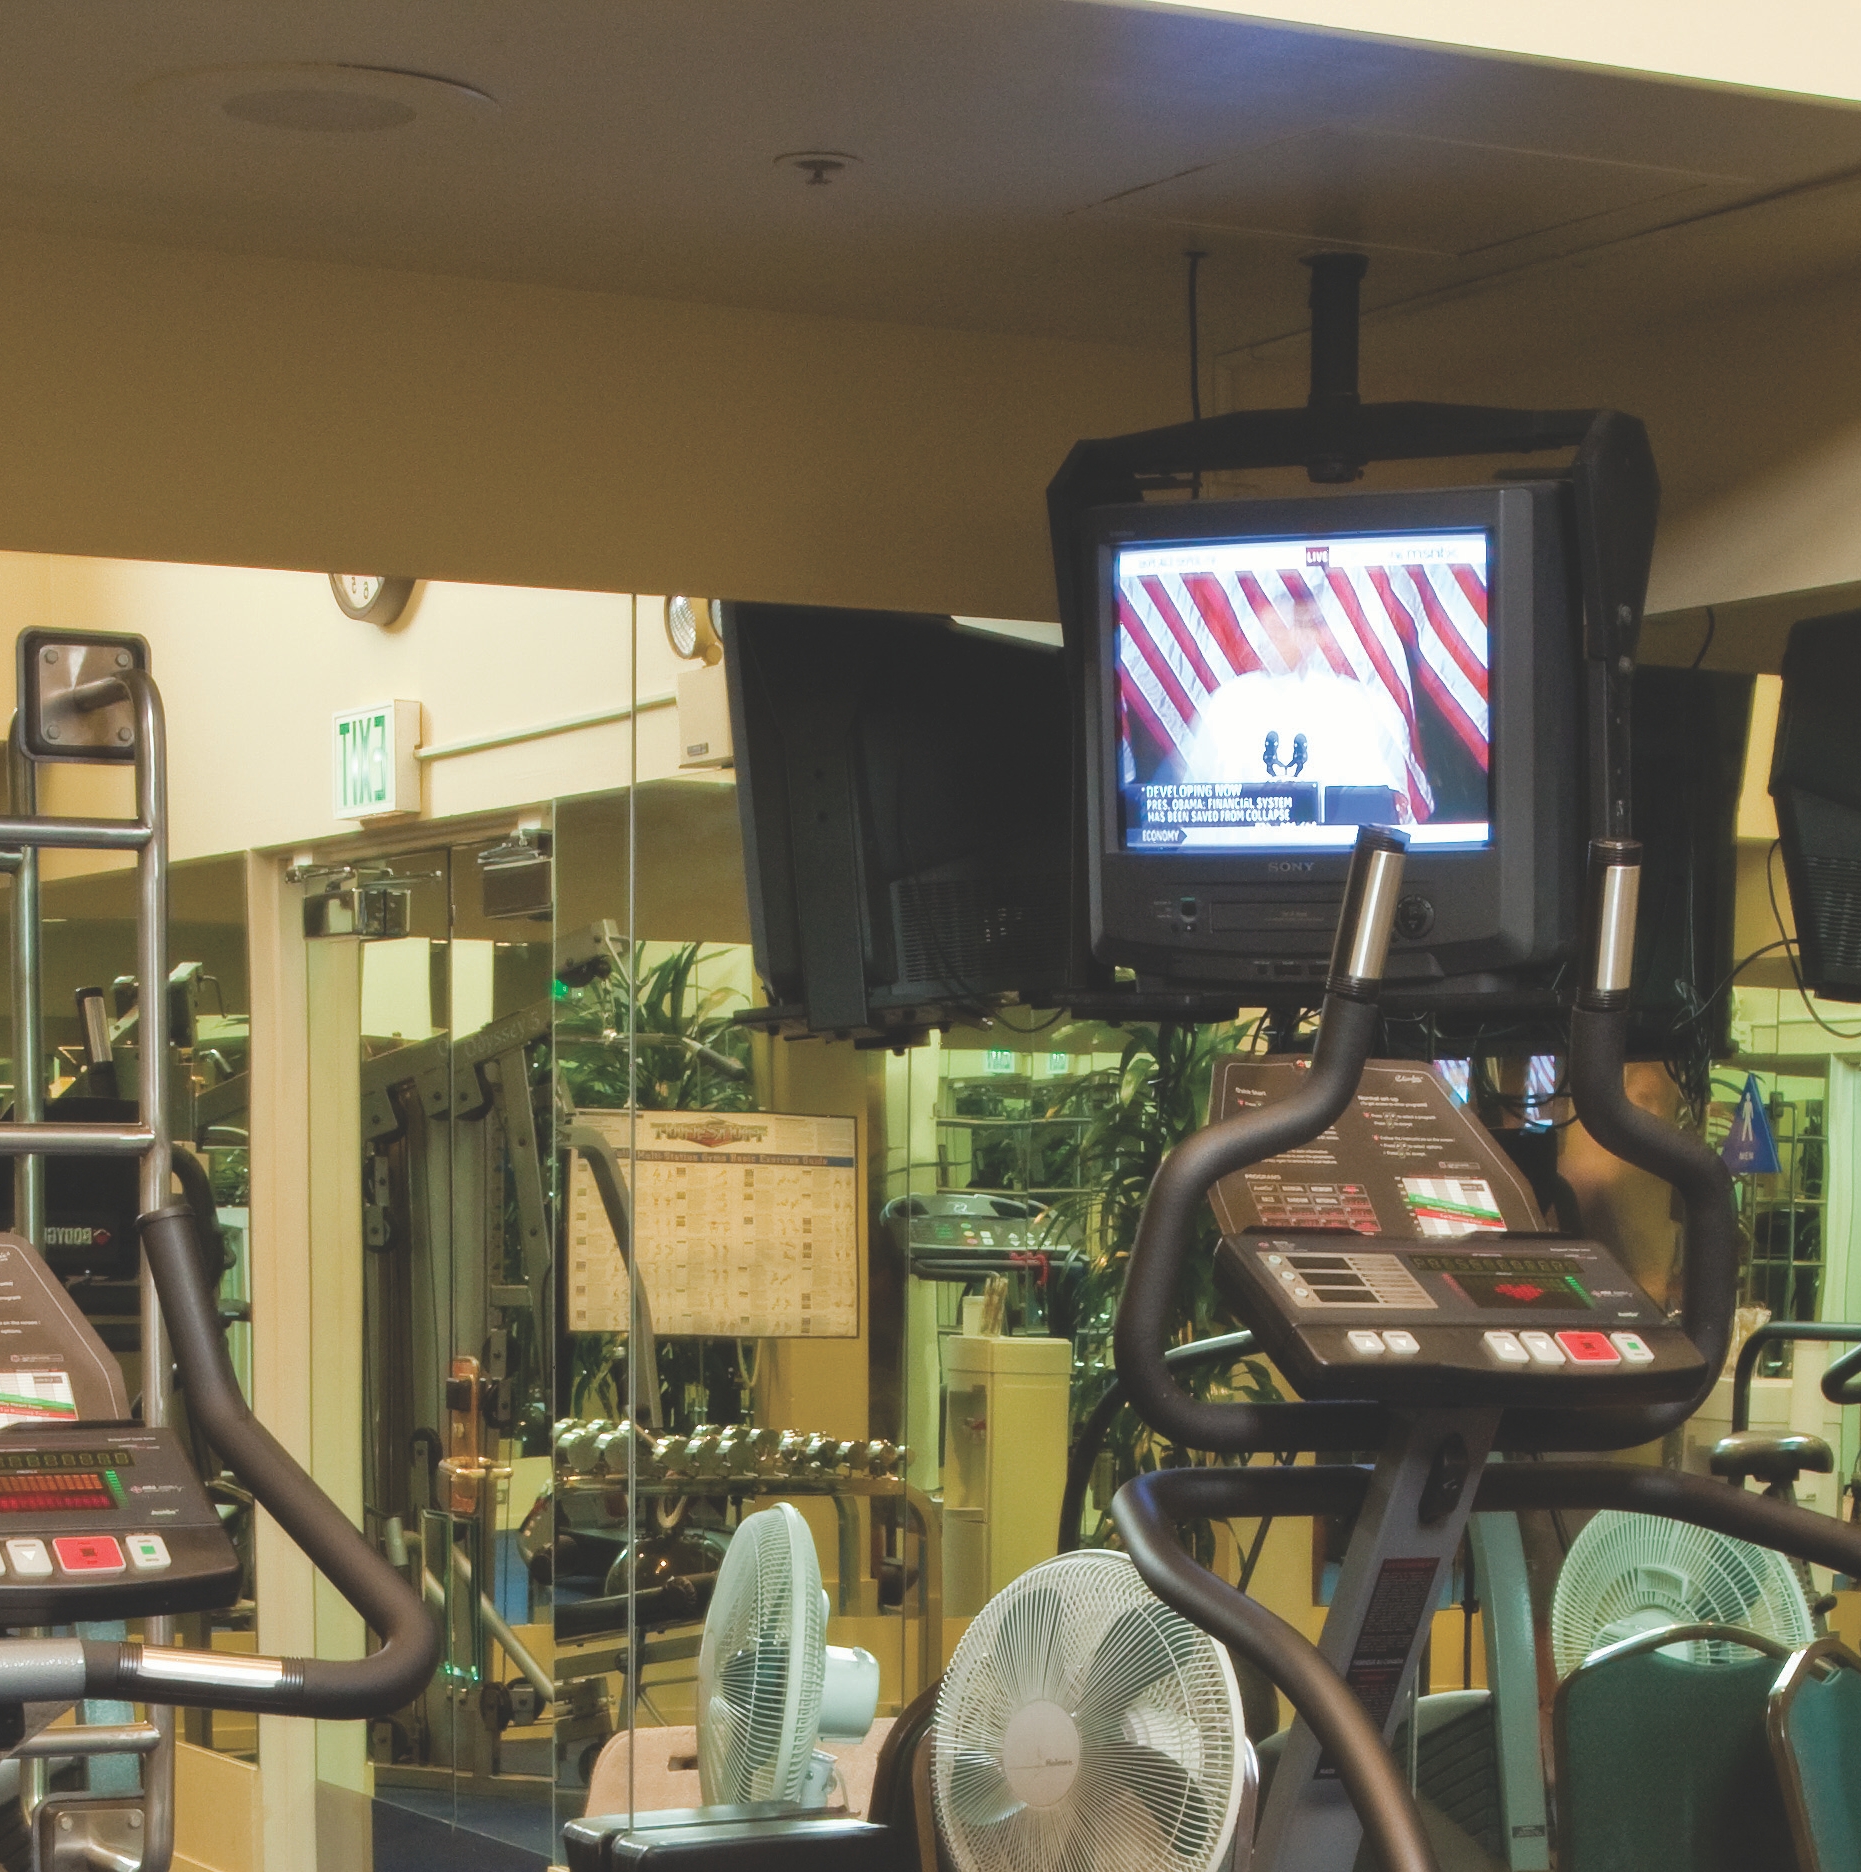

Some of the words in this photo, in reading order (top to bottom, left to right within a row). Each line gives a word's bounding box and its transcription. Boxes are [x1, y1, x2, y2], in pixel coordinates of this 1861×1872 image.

[1306, 549, 1328, 563] LIVE
[1146, 785, 1213, 798] DEVELOPING
[1214, 784, 1242, 797] NOW
[1146, 799, 1170, 810] PRES.
[1172, 798, 1206, 810] OBAMA:
[1207, 797, 1254, 810] FINANCIAL
[1256, 797, 1293, 808] SYSTEM
[1148, 811, 1166, 823] HAS
[1167, 811, 1189, 823] BEEN
[1191, 810, 1218, 822] SAVED
[1220, 809, 1244, 822] FROM
[1246, 808, 1290, 821] COLLAPSE
[1142, 830, 1179, 843] ECONOMY
[1268, 862, 1315, 872] SONY
[759, 1154, 799, 1165] Exercise
